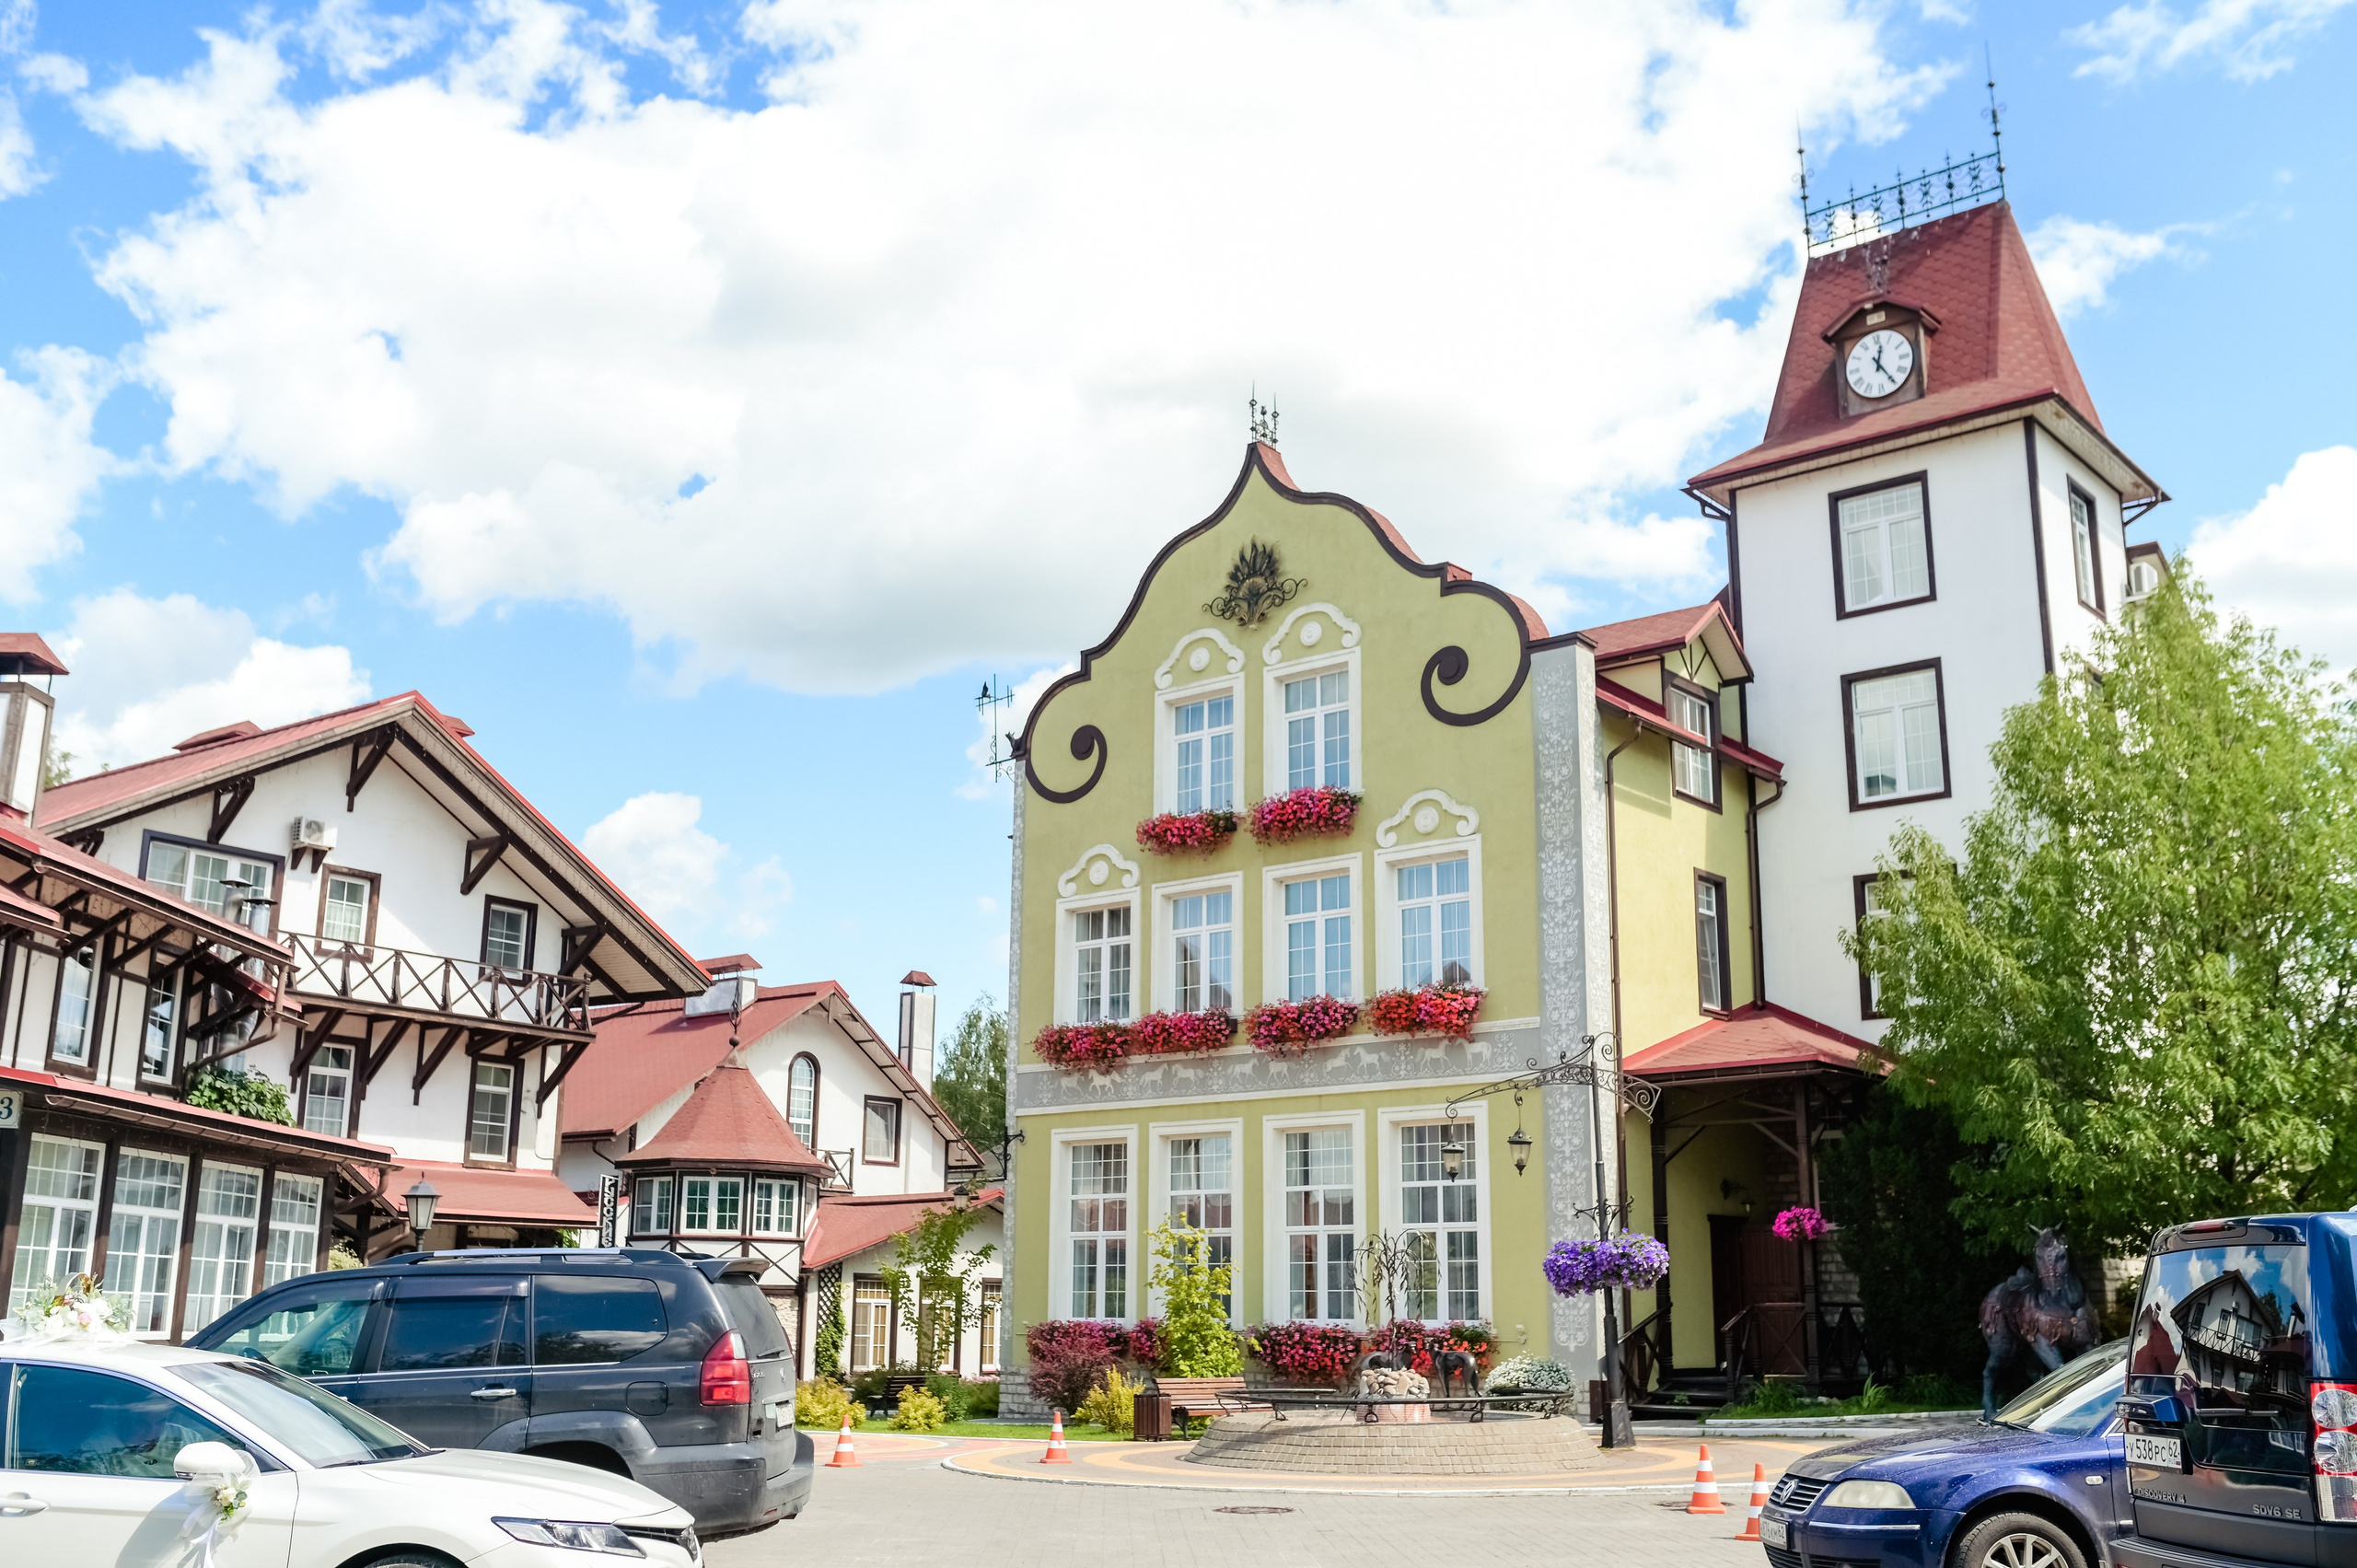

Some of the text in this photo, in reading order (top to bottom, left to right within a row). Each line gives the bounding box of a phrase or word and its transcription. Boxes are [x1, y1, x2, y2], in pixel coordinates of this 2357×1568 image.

[0, 1097, 13, 1120] 3
[2137, 1487, 2177, 1503] DISCOVERY
[2252, 1504, 2301, 1519] SDV6 SE
